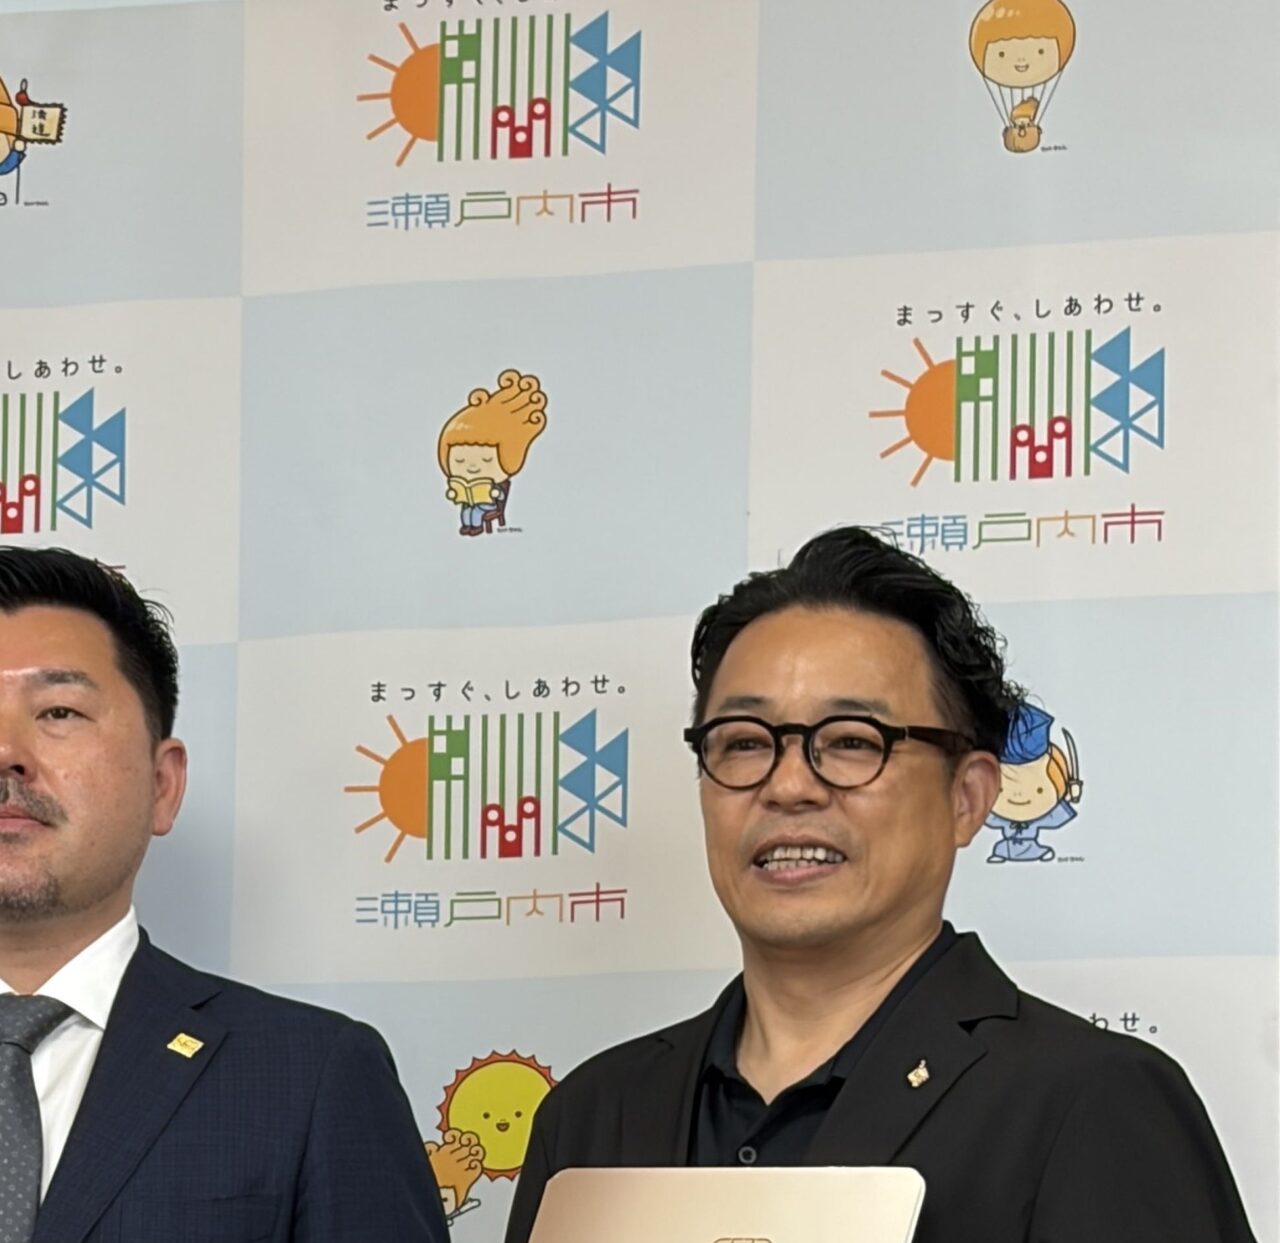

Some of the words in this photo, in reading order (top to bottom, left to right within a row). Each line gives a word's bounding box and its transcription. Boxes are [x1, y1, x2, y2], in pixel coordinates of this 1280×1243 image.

[367, 182, 640, 231] 瀬戸内市
[896, 291, 1162, 326] まっすぐ、しあわせ。
[881, 503, 1166, 554] 瀬戸内市
[371, 674, 626, 702] まっすぐ、しあわせ。
[356, 882, 628, 929] 瀬戸内市
